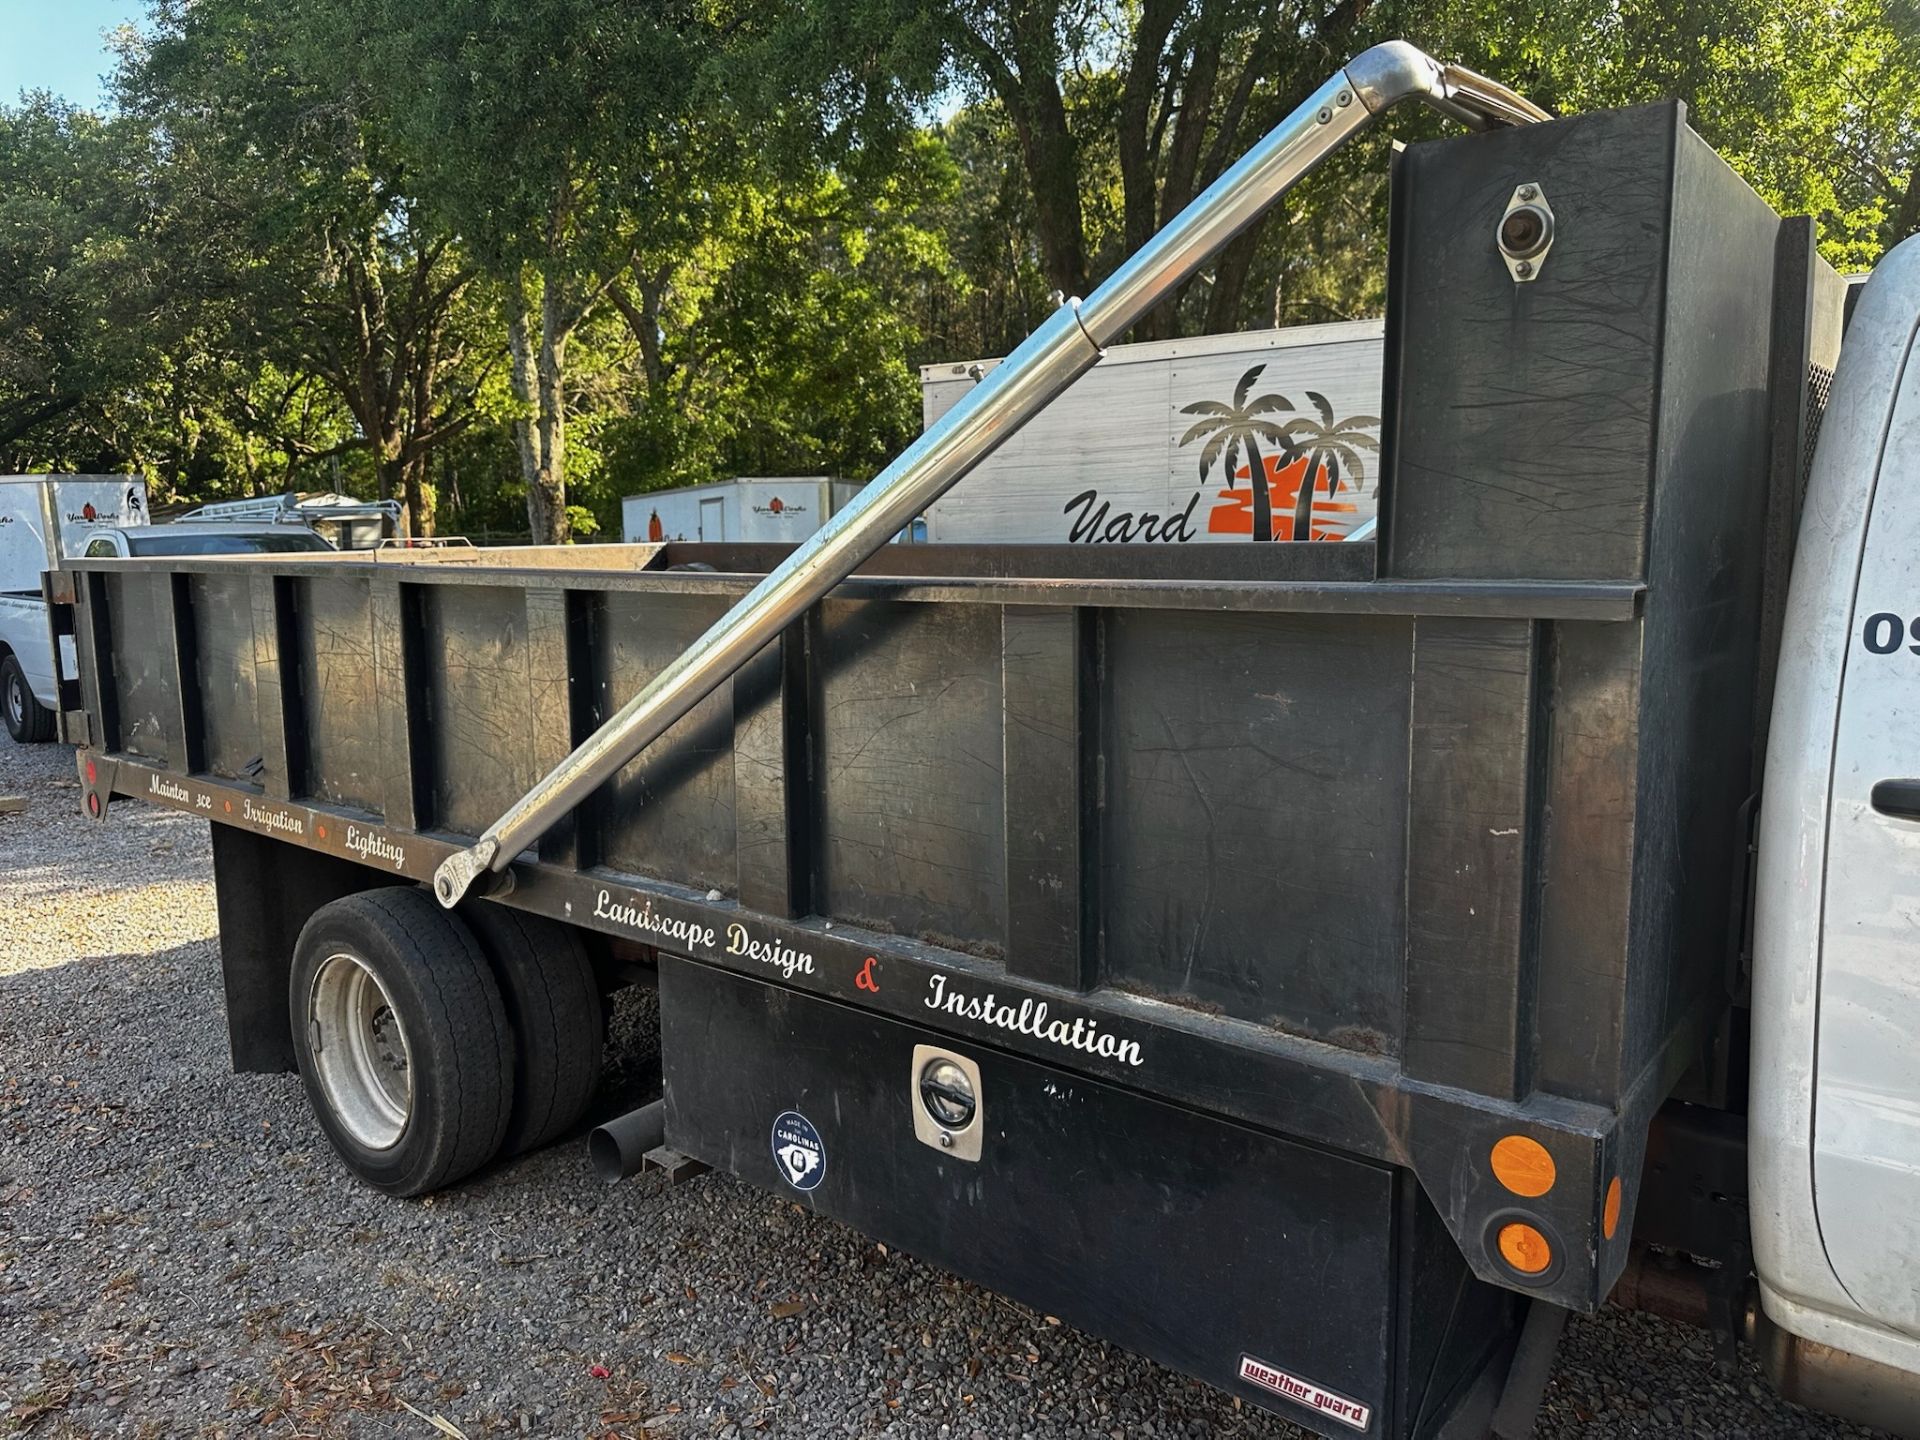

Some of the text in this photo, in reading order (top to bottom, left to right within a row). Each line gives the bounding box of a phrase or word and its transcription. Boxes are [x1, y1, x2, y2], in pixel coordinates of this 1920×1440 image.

[1064, 489, 1200, 543] Yard
[1863, 612, 1920, 656] 0
[243, 798, 304, 834] Irrigation
[345, 825, 406, 869] Lighting
[593, 889, 1144, 1067] Landscape Design & Installation
[777, 1129, 820, 1151] CAROLINAS
[1244, 1363, 1363, 1421] weather guard
